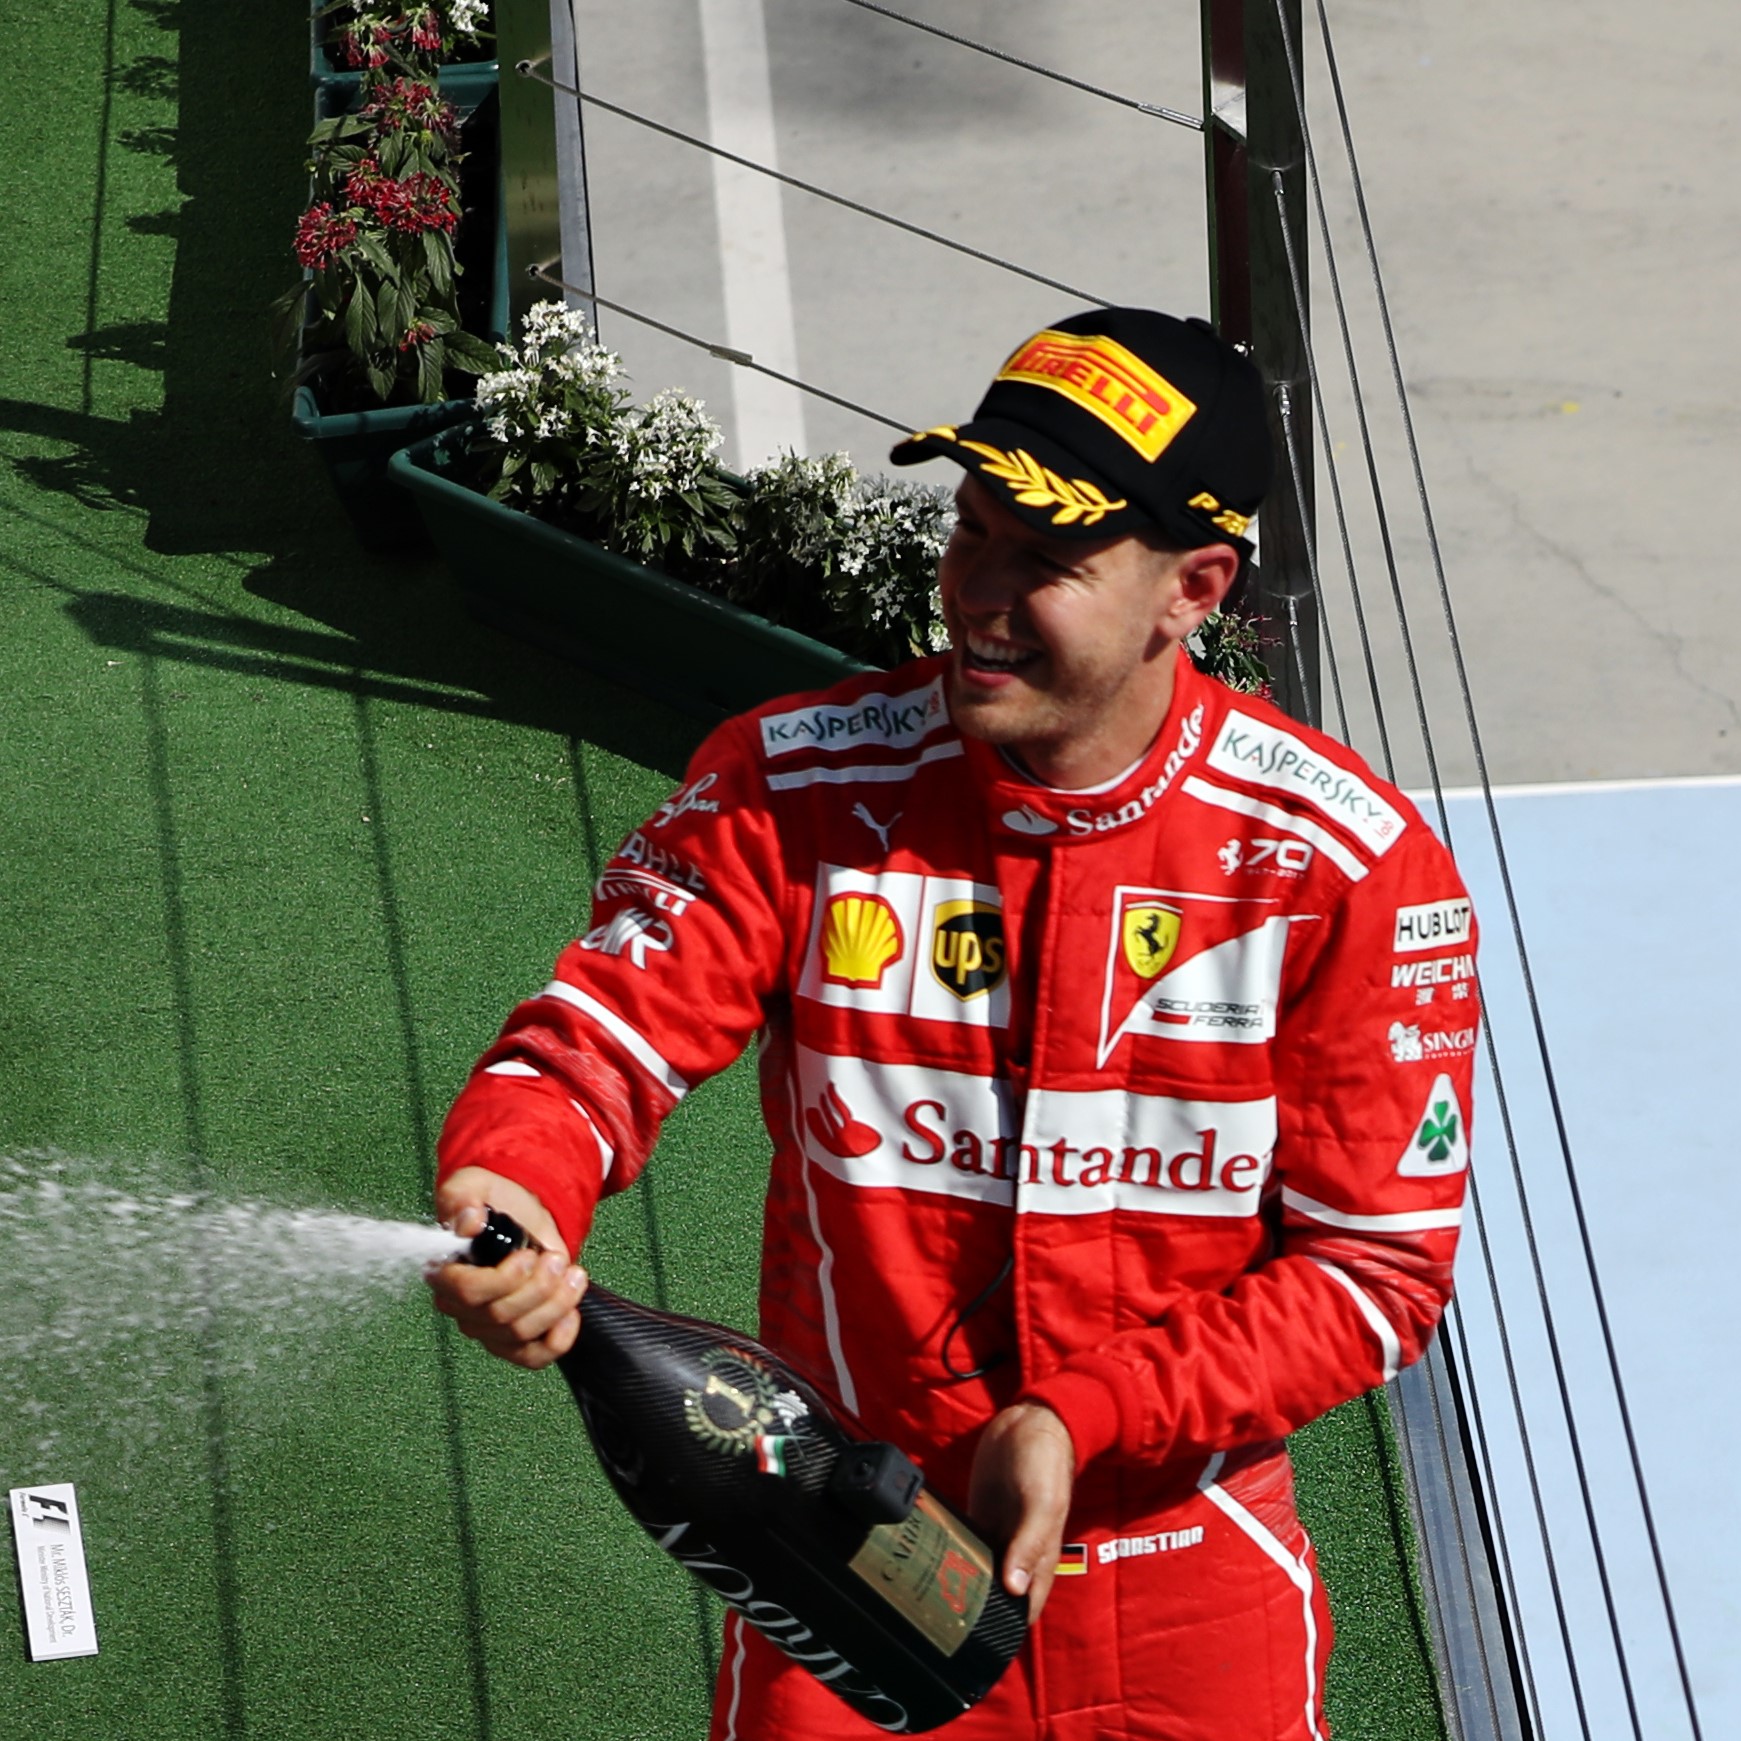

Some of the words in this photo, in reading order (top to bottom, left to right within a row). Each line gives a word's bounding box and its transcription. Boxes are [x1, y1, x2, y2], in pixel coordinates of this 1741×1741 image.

[1008, 340, 1171, 436] PIRELLI
[769, 698, 929, 743] KASPERSKY
[1066, 702, 1205, 836] Santande
[1222, 728, 1383, 823] KASPERSKY
[1245, 838, 1314, 872] 70
[1397, 907, 1469, 942] HUBLOT
[936, 929, 1004, 985] ups
